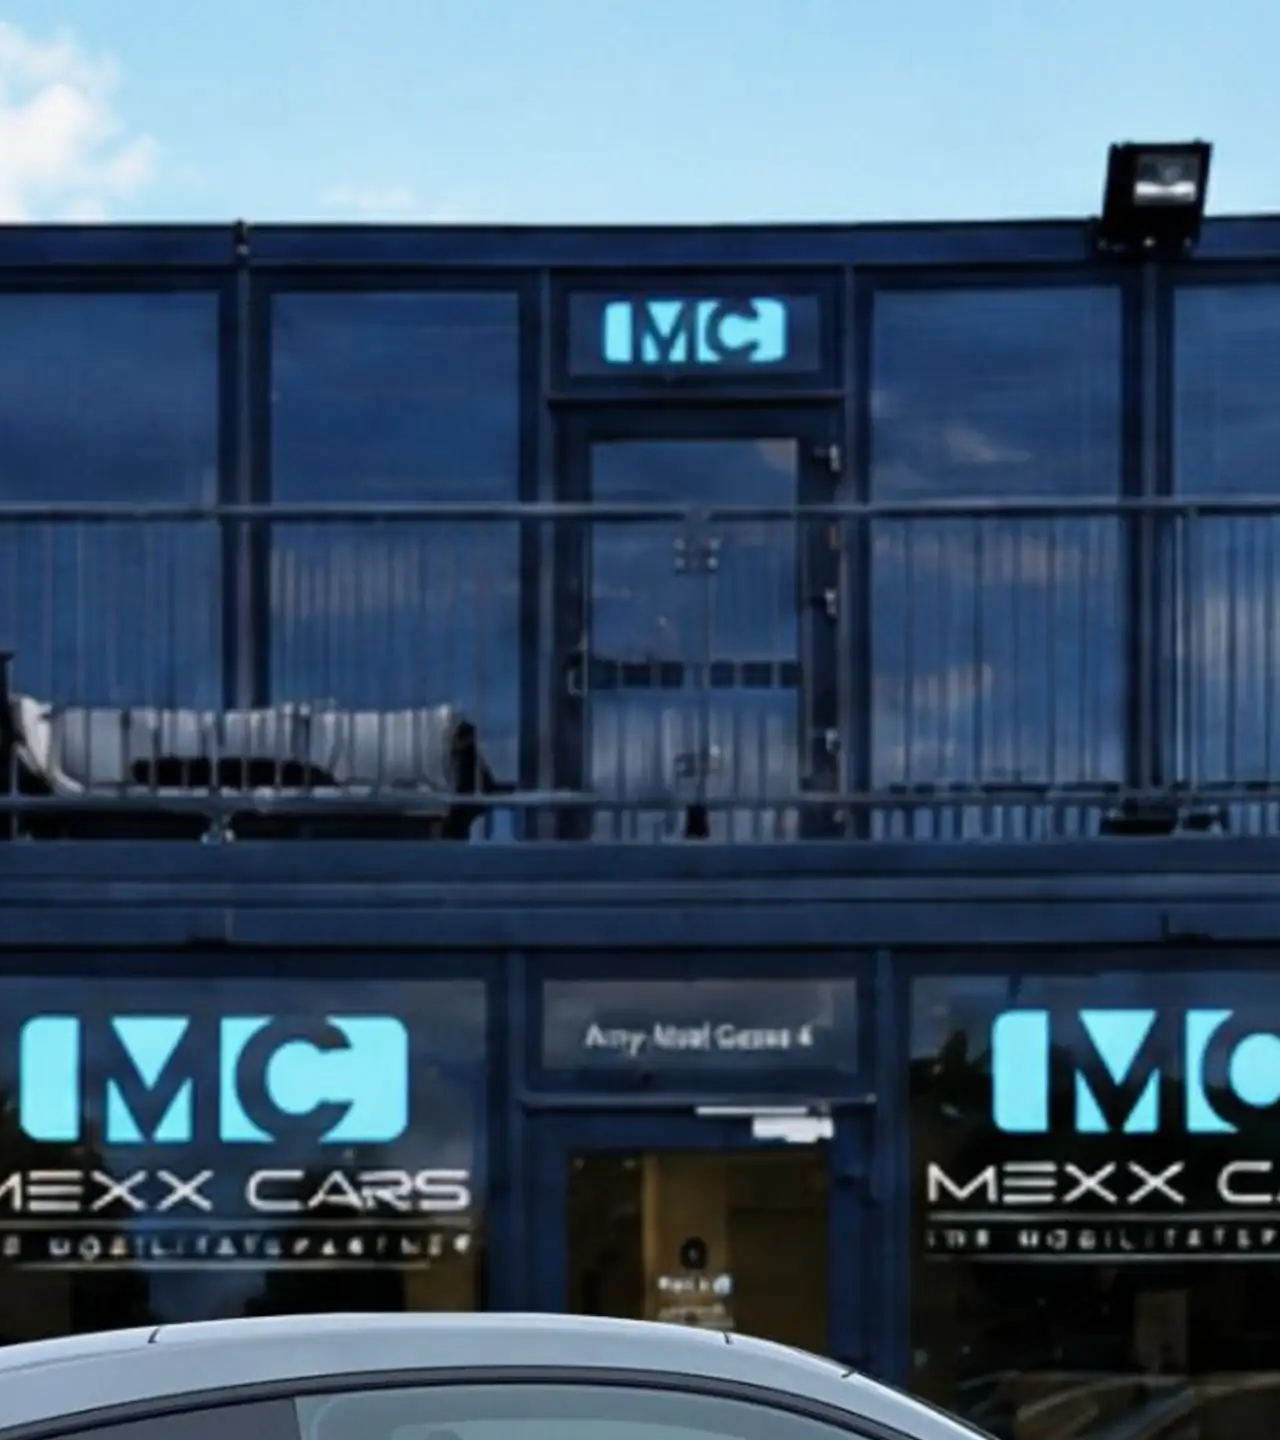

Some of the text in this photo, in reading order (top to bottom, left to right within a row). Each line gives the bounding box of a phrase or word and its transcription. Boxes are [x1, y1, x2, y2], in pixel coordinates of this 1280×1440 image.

[603, 297, 787, 363] MC
[19, 1016, 409, 1143] MC
[245, 1167, 471, 1212] CARS
[927, 1161, 1185, 1204] MEXX
